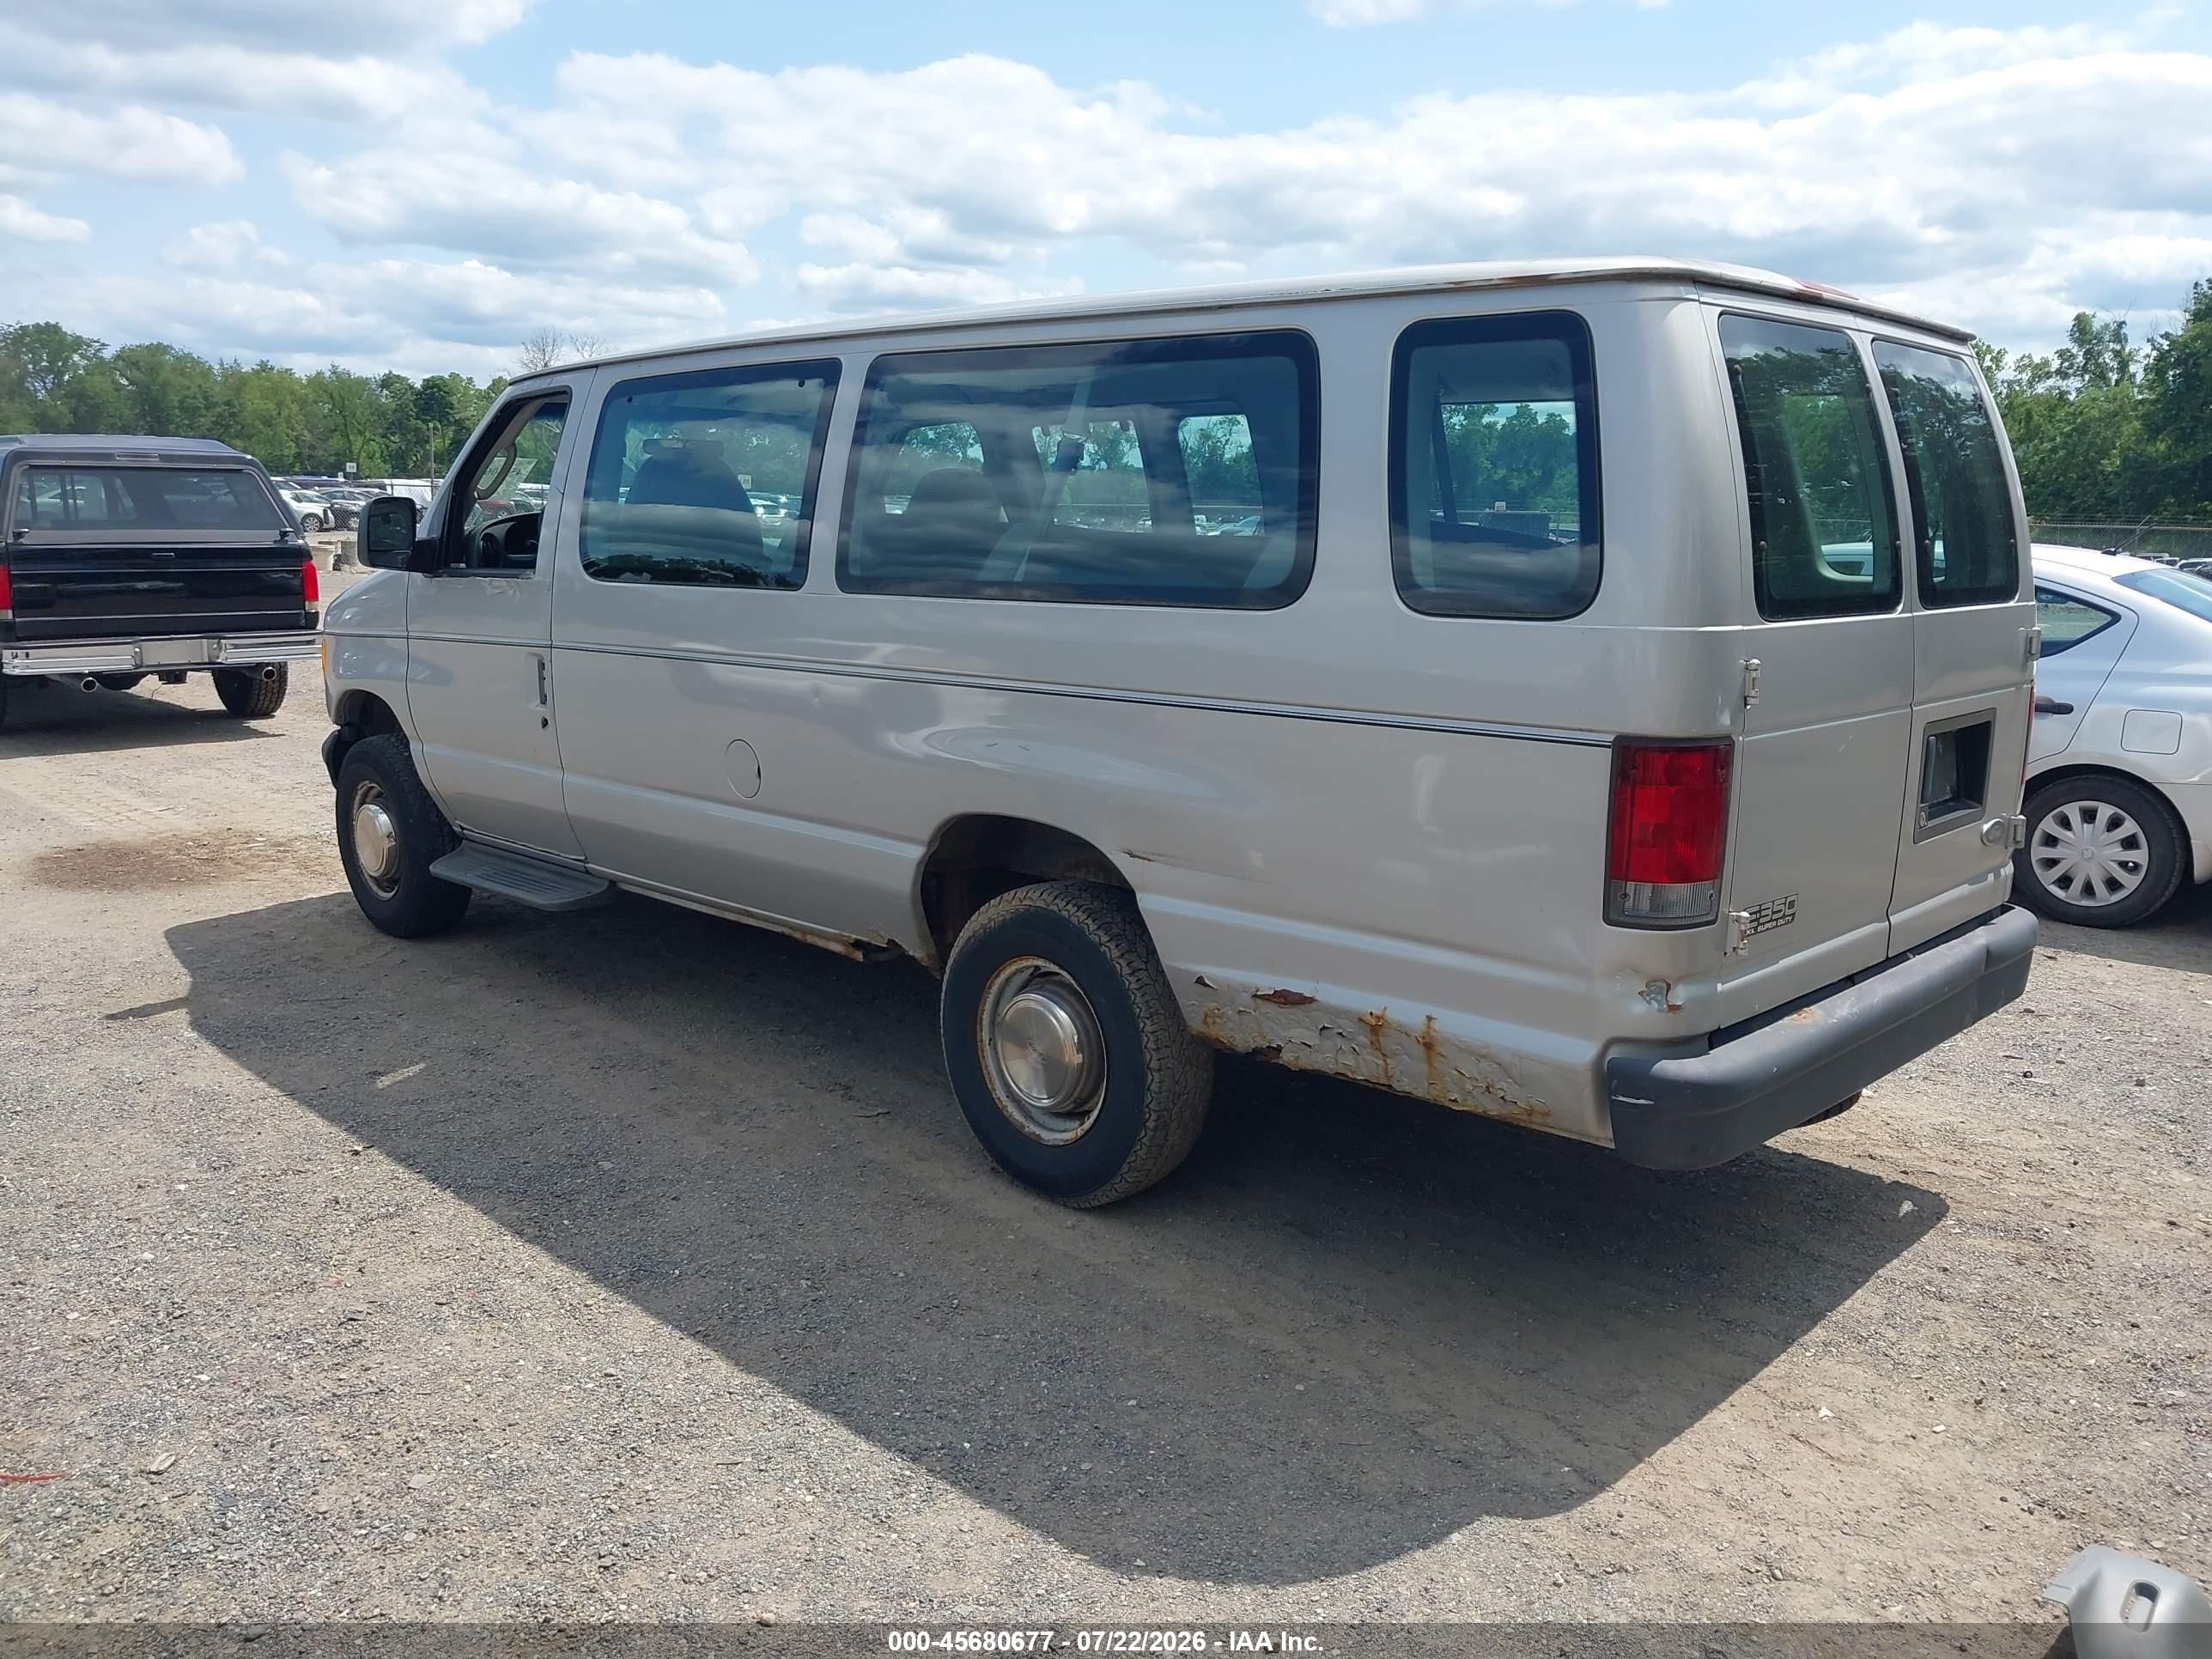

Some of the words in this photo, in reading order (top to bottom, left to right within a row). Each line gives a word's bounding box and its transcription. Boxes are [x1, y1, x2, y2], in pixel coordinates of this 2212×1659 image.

[1745, 927, 1756, 936] XL
[1757, 921, 1777, 933] SUPER
[1778, 915, 1793, 926] DUTY
